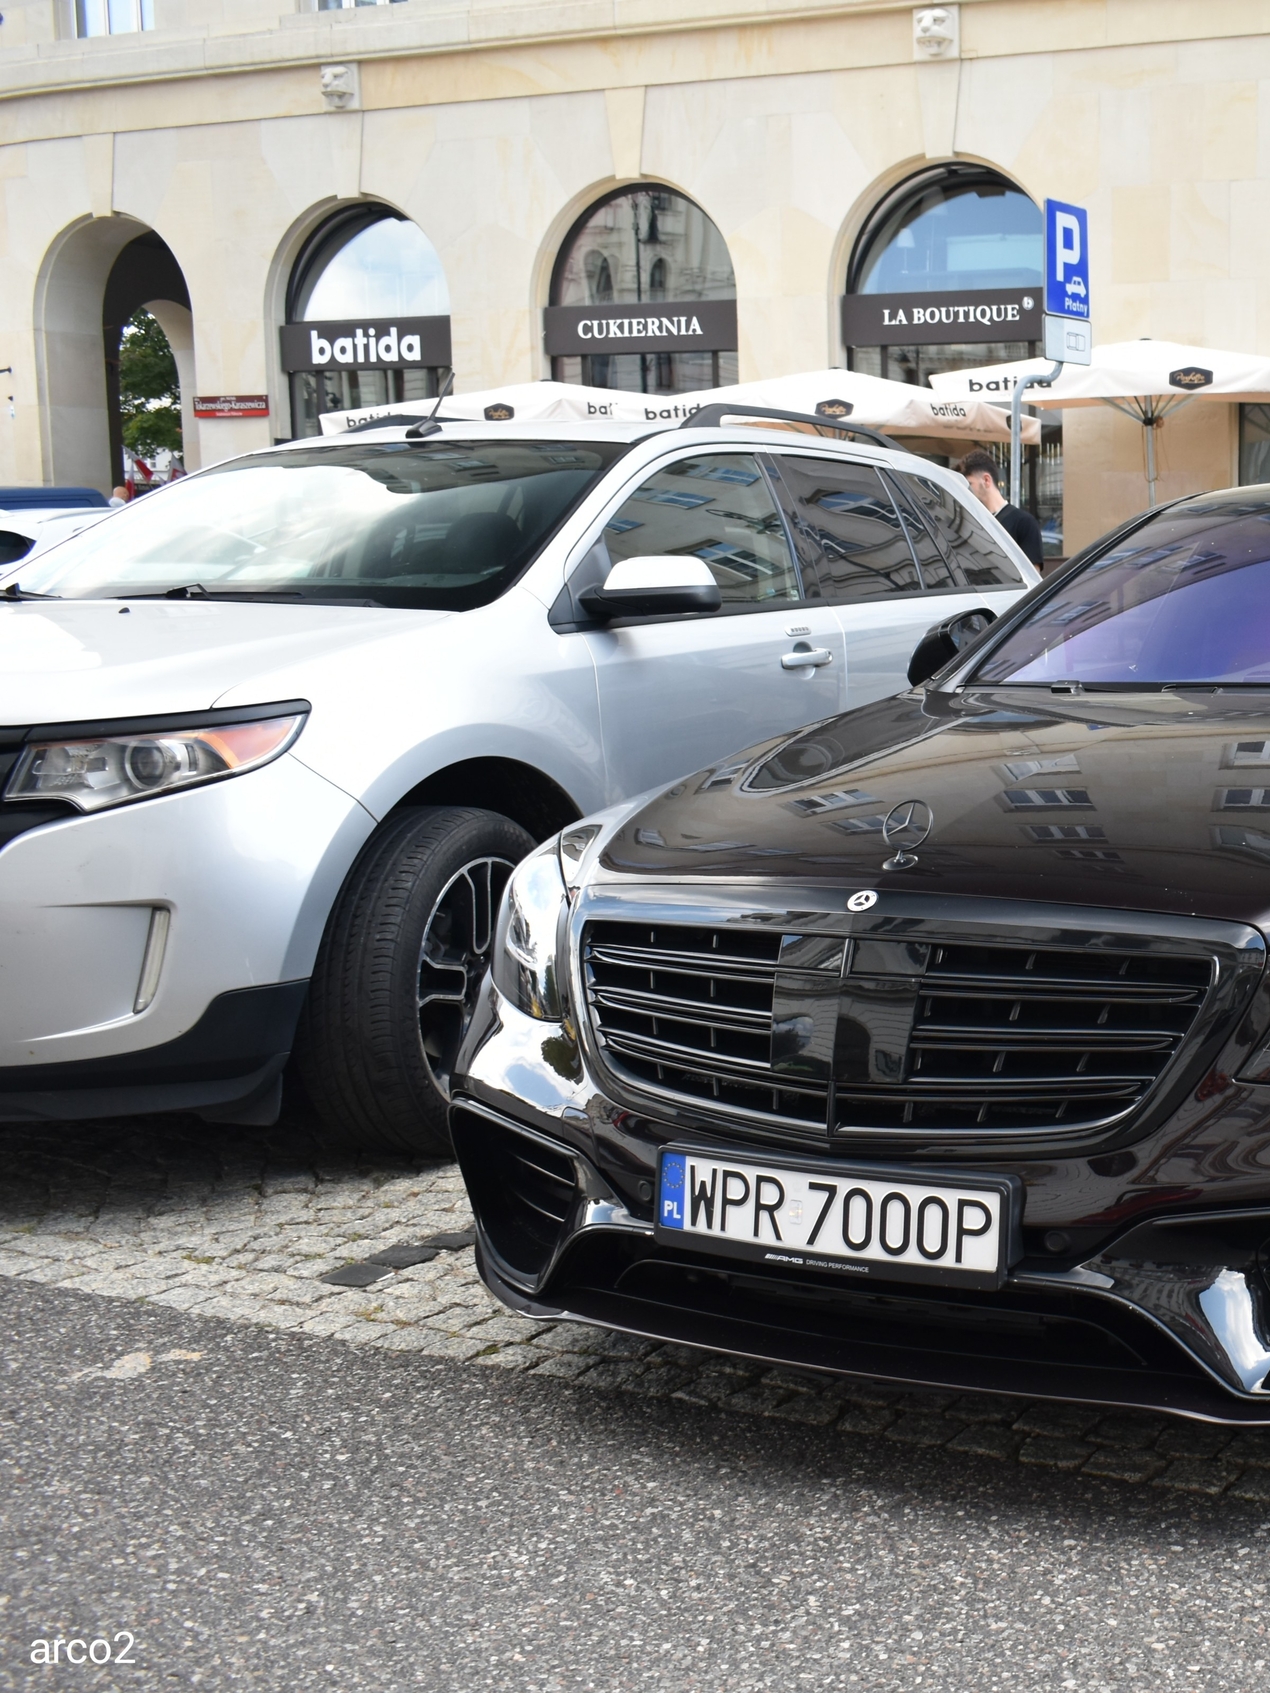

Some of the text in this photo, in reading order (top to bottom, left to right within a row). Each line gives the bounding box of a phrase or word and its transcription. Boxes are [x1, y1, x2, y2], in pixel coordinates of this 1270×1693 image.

[1056, 211, 1080, 282] P
[883, 309, 908, 325] LA
[912, 304, 1020, 325] BOUTIQUE
[577, 316, 703, 339] CUKIERNIA
[310, 327, 421, 364] batida
[644, 403, 700, 420] batid
[931, 403, 967, 417] batida
[663, 1200, 681, 1219] PL
[690, 1164, 993, 1263] WPR 7000P
[775, 1255, 870, 1273] AMG DRIVING PERFORMANCE
